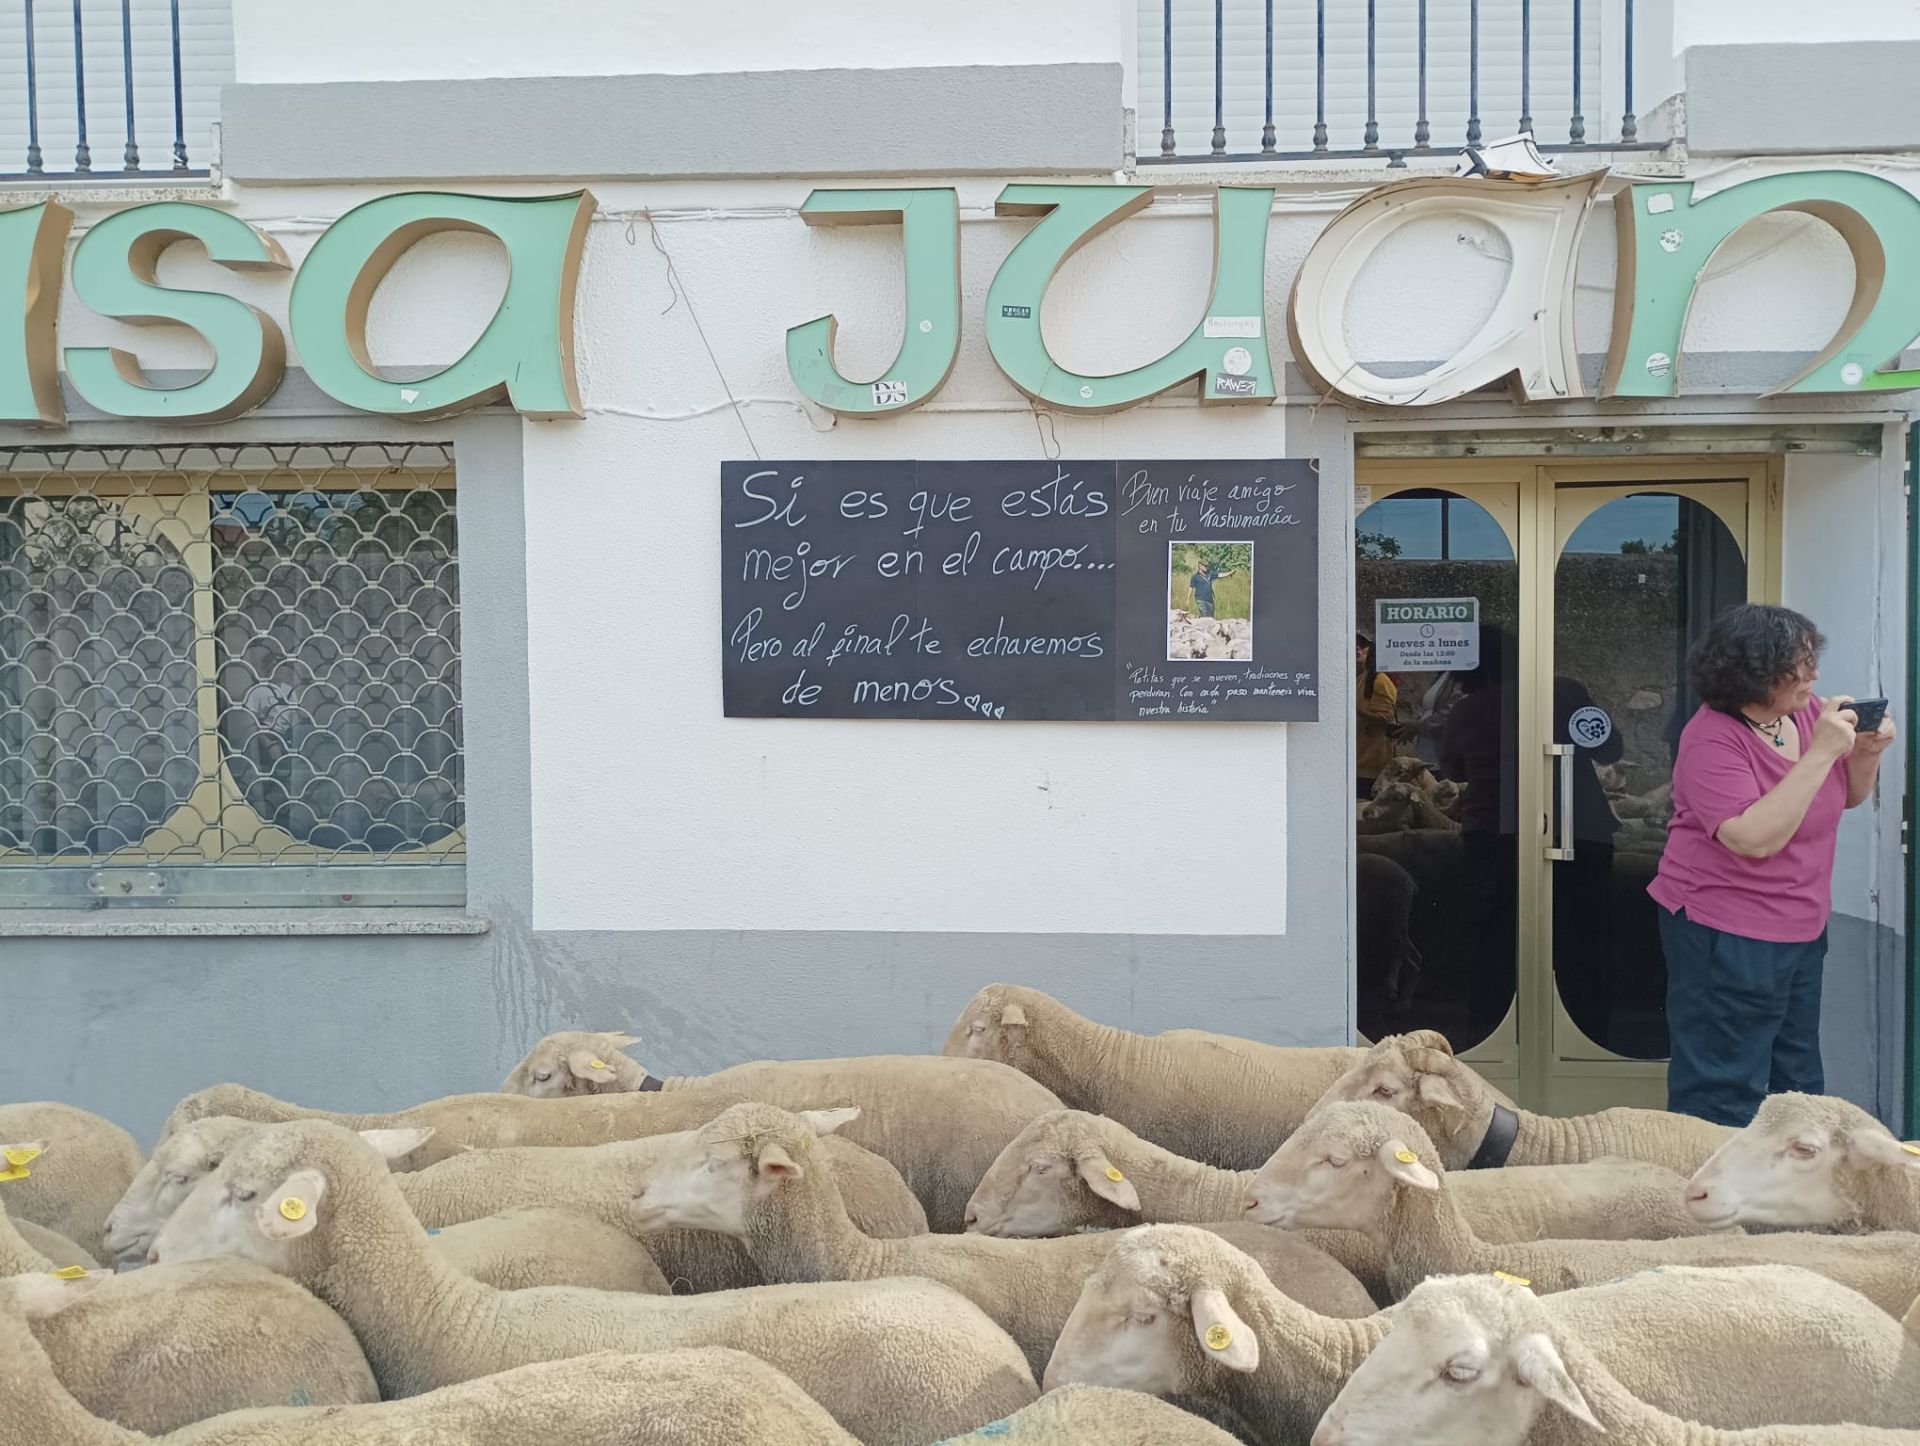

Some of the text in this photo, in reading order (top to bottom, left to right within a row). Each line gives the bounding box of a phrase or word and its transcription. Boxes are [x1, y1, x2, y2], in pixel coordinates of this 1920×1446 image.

[786, 170, 1920, 419] Juan
[734, 464, 1109, 541] Si es que estás
[1121, 470, 1296, 516] Buen viaje amigo
[1139, 505, 1300, 534] en tu trashumancia
[743, 541, 856, 610] mejor
[877, 541, 923, 579] en
[943, 532, 980, 576] el
[1387, 606, 1467, 620] HORARIO
[732, 608, 1104, 666] Pero al final te echaremos
[1386, 639, 1425, 648] Jueves
[1439, 638, 1470, 647] lunes
[782, 669, 824, 706] de
[1171, 675, 1186, 688] que
[1192, 675, 1200, 683] se
[1294, 672, 1311, 685] que
[1226, 687, 1247, 701] paso
